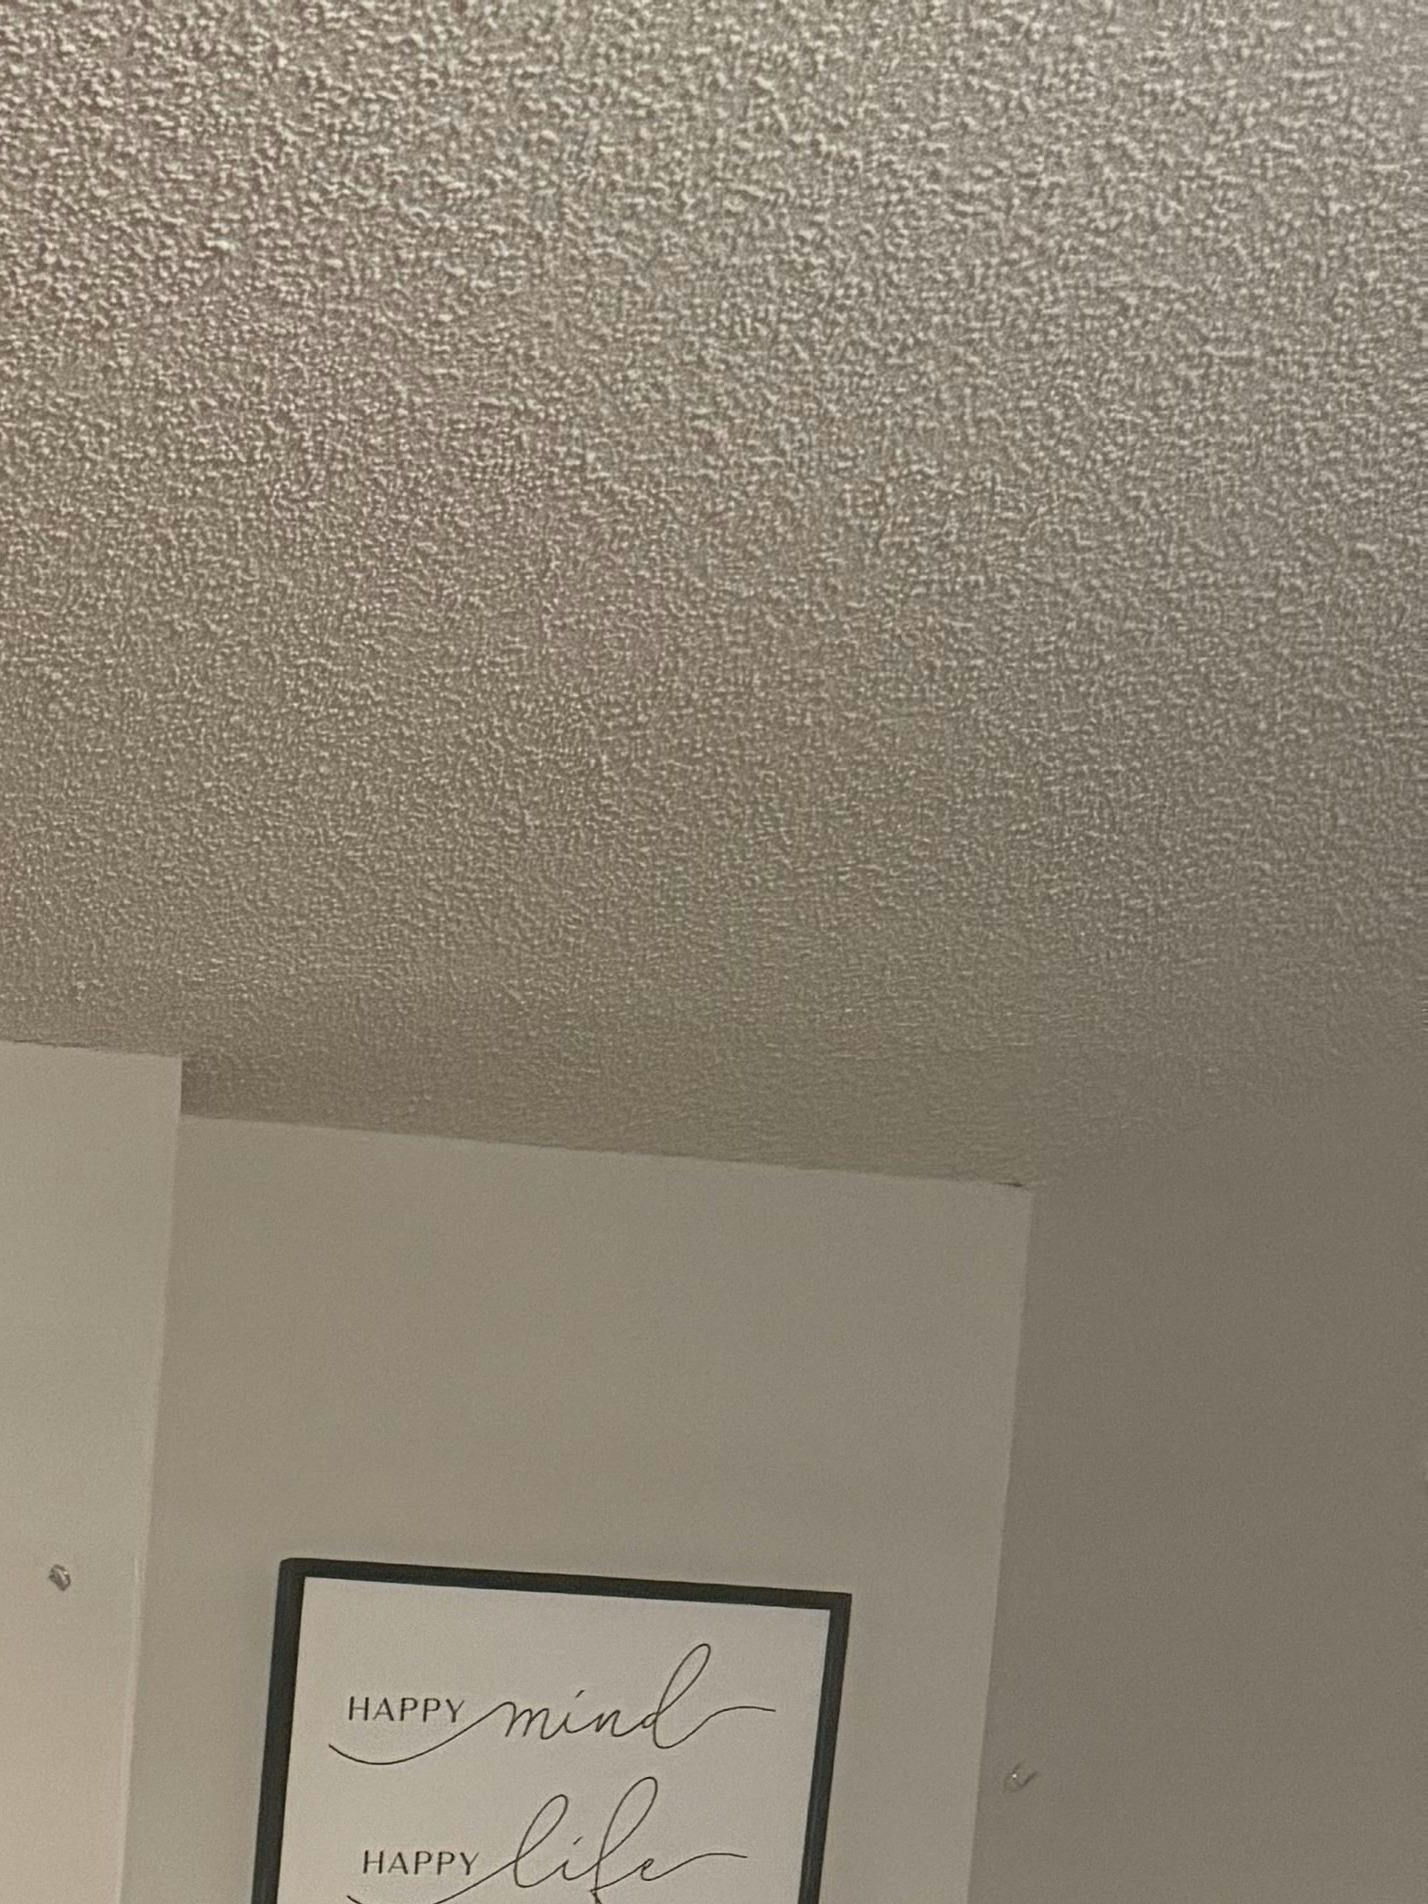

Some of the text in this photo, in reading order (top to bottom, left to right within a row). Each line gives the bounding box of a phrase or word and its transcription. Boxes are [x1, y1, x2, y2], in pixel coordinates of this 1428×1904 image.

[347, 1643, 776, 1757] HAPPY mind
[362, 1849, 481, 1877] HAPPY
